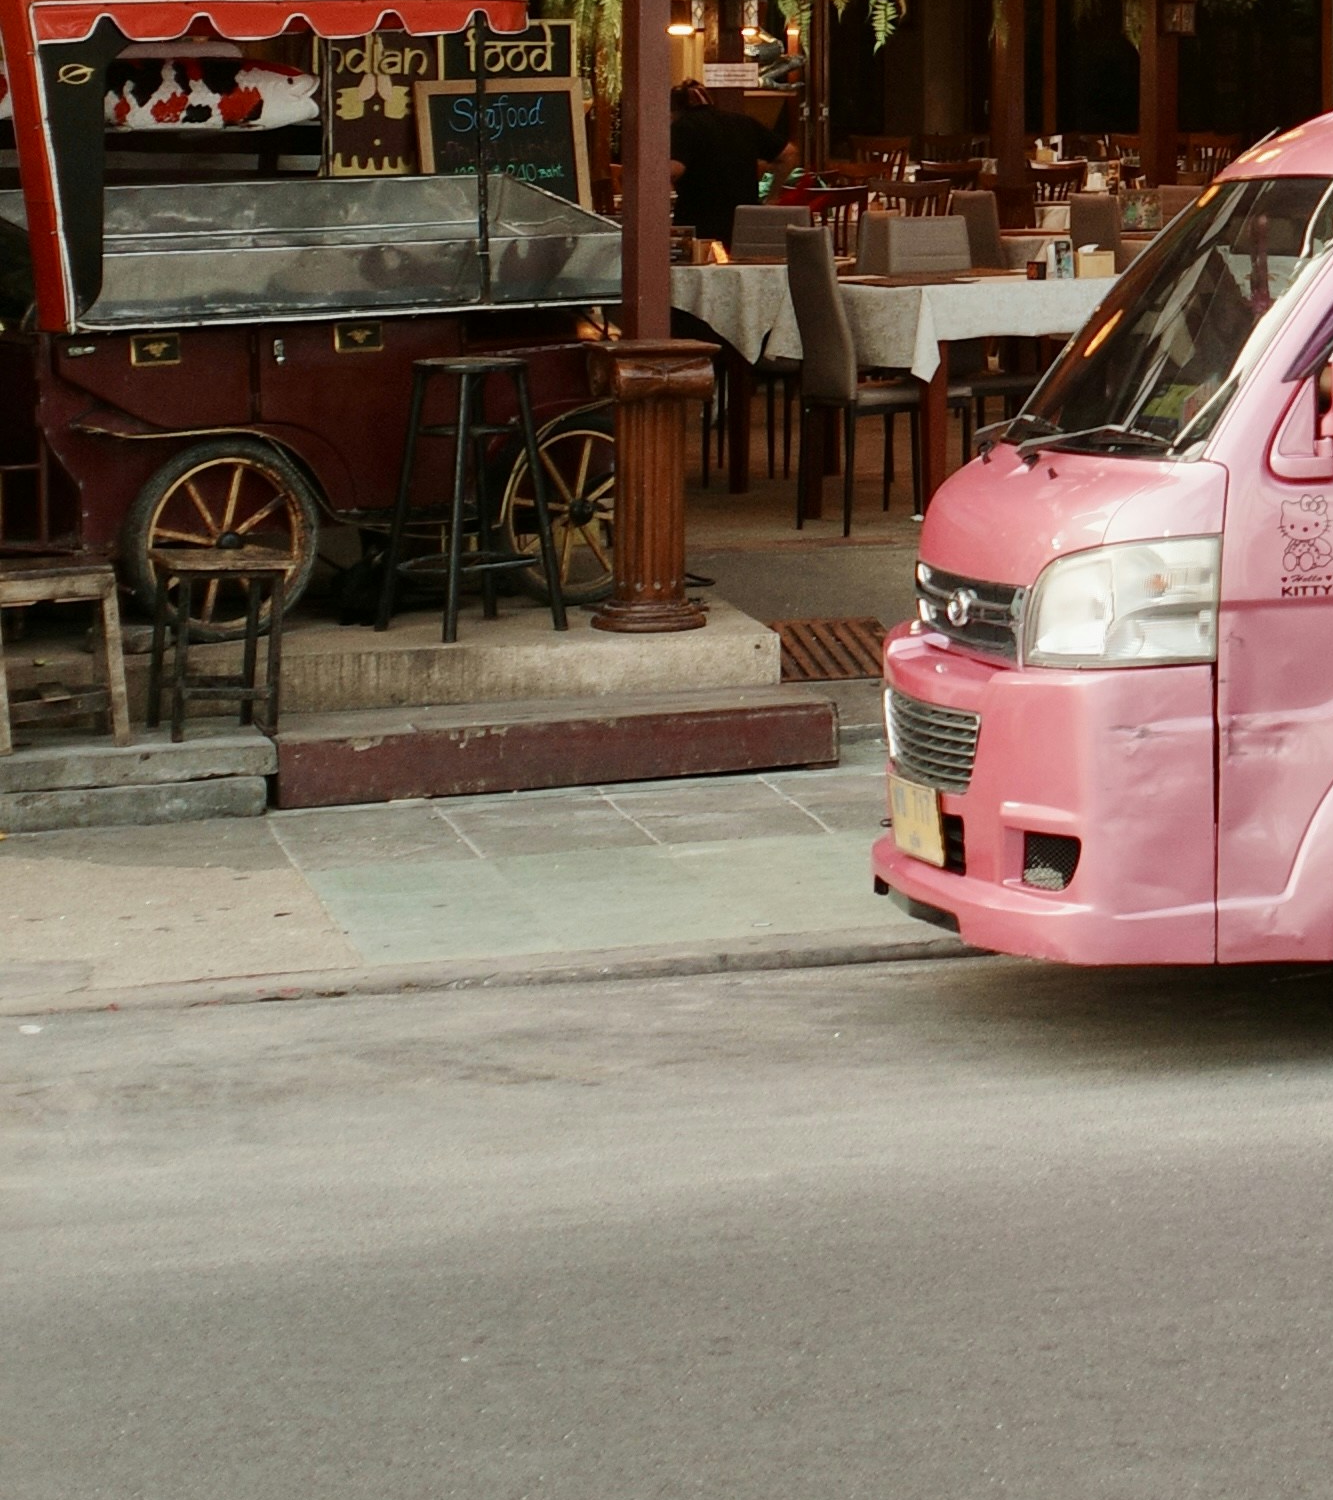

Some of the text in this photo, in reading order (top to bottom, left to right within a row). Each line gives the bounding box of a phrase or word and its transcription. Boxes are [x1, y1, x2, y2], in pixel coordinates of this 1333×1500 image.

[464, 22, 555, 72] food
[449, 95, 545, 140] Safood
[1281, 584, 1332, 597] KITTY
